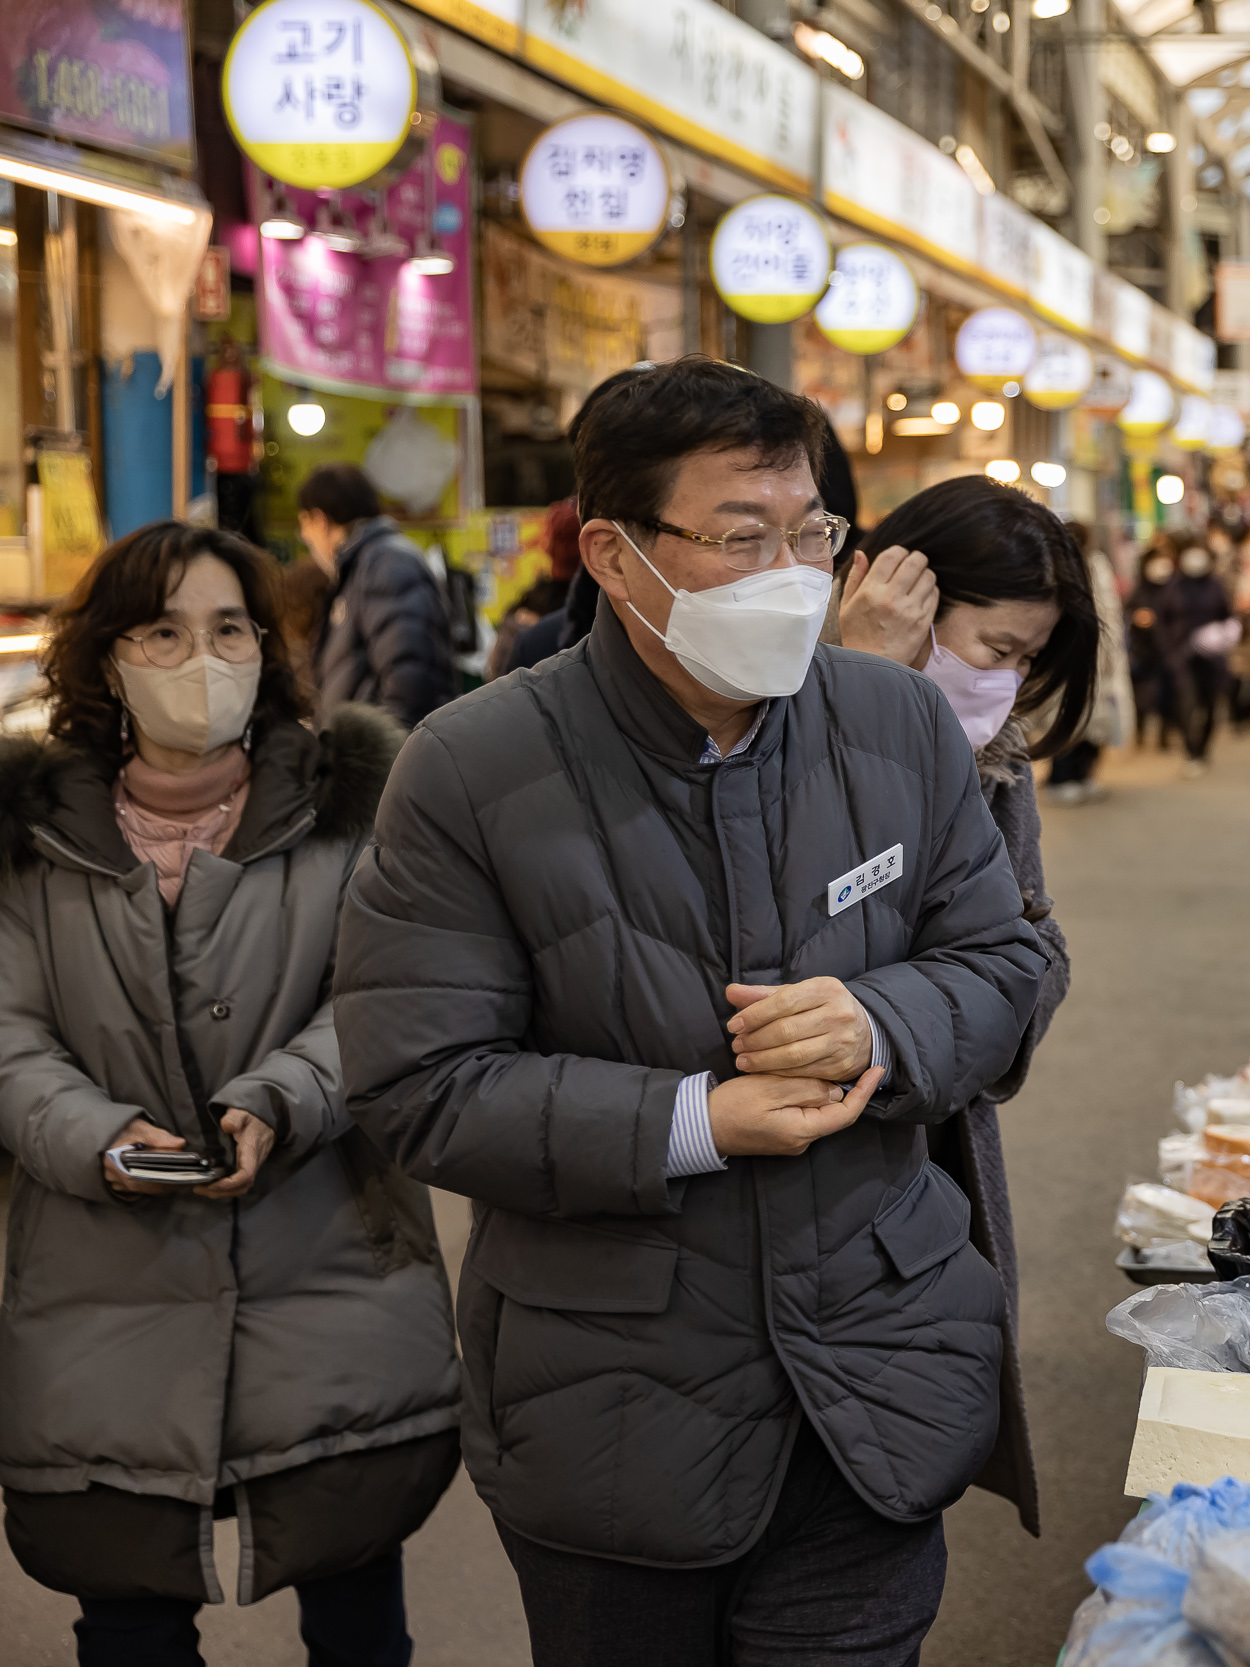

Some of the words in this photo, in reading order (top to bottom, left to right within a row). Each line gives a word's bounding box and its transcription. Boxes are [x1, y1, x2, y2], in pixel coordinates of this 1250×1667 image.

[274, 18, 363, 65] 고기
[274, 76, 366, 130] 사랑
[856, 855, 896, 887] 김경호
[861, 871, 891, 894] 광진구청장
